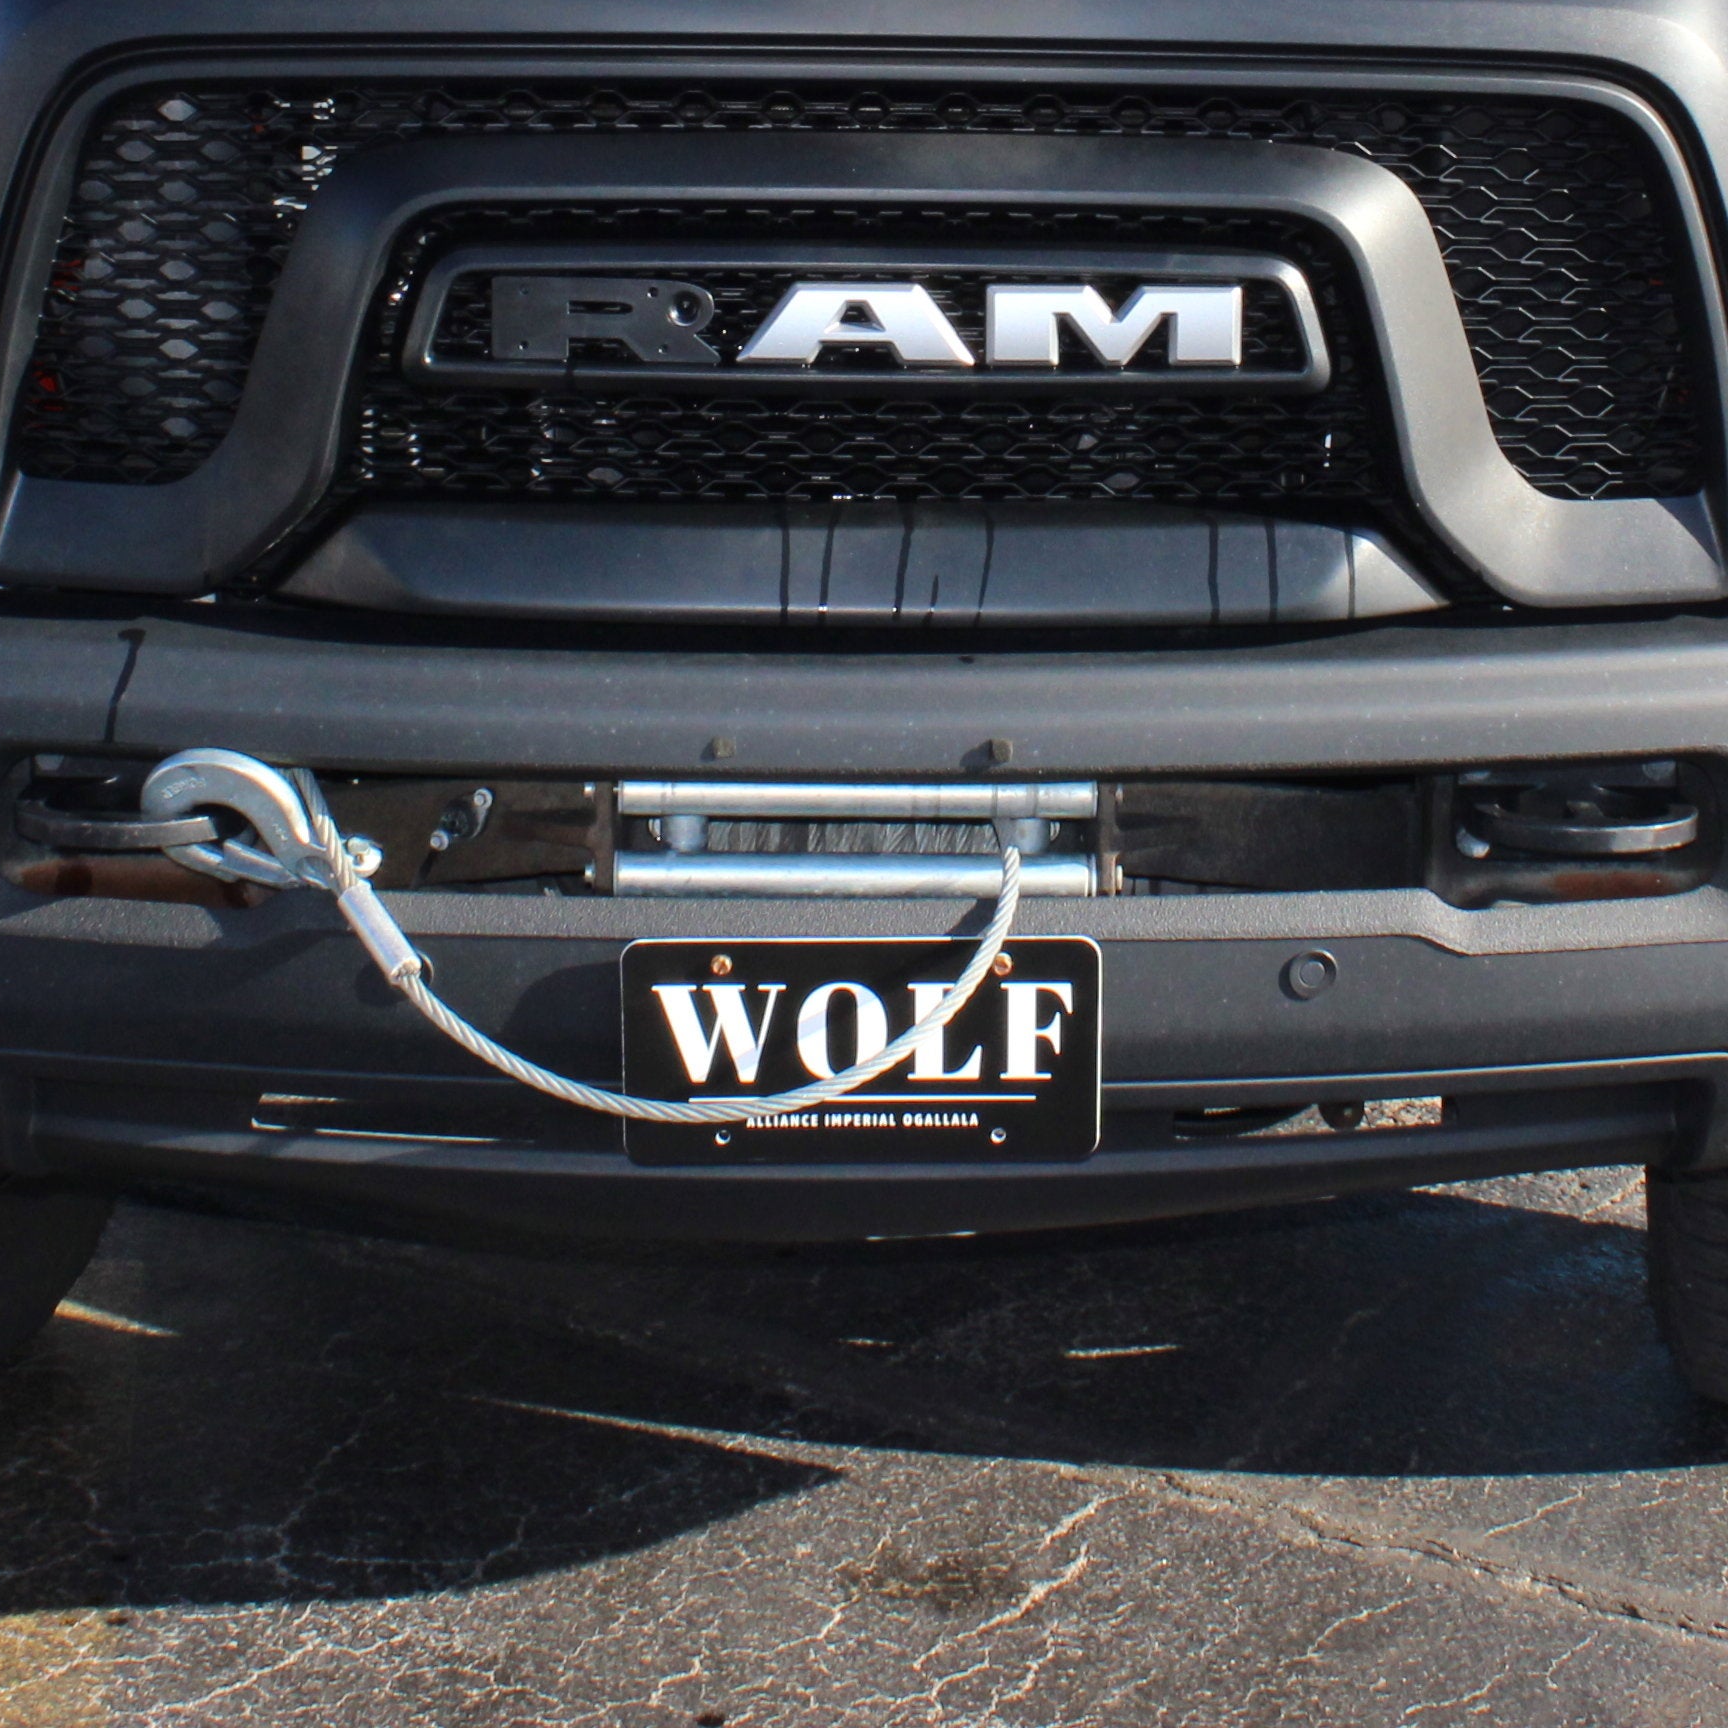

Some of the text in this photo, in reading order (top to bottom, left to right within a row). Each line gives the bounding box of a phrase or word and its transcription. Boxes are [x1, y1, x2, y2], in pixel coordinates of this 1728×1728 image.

[492, 276, 1244, 366] RAM
[651, 981, 1074, 1084] WOLF
[746, 1111, 980, 1129] ALLIANCE IMPERIAL OGALLALA
